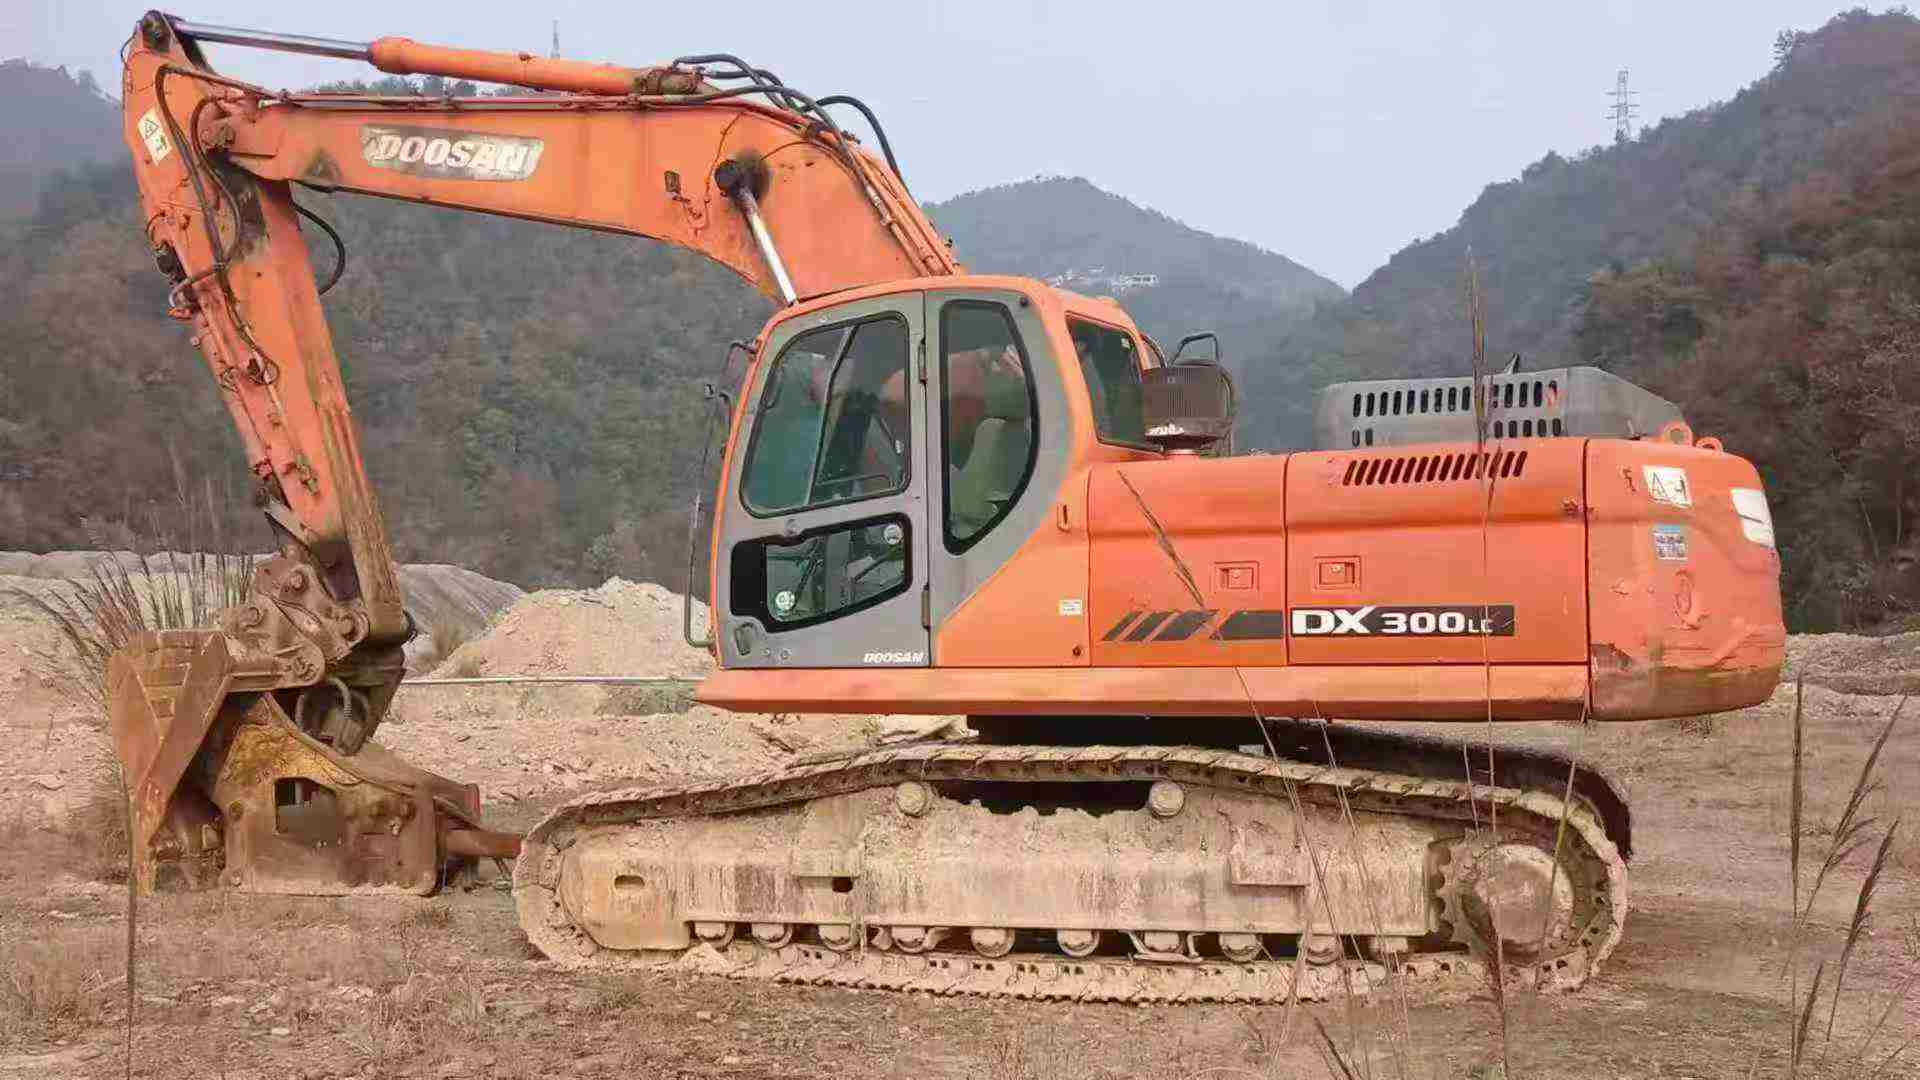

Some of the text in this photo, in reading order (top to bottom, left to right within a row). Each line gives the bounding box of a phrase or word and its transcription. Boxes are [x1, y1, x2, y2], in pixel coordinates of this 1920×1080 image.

[371, 134, 529, 171] DOOSAN
[1292, 606, 1376, 634] DX
[864, 651, 924, 663] DOOSAN
